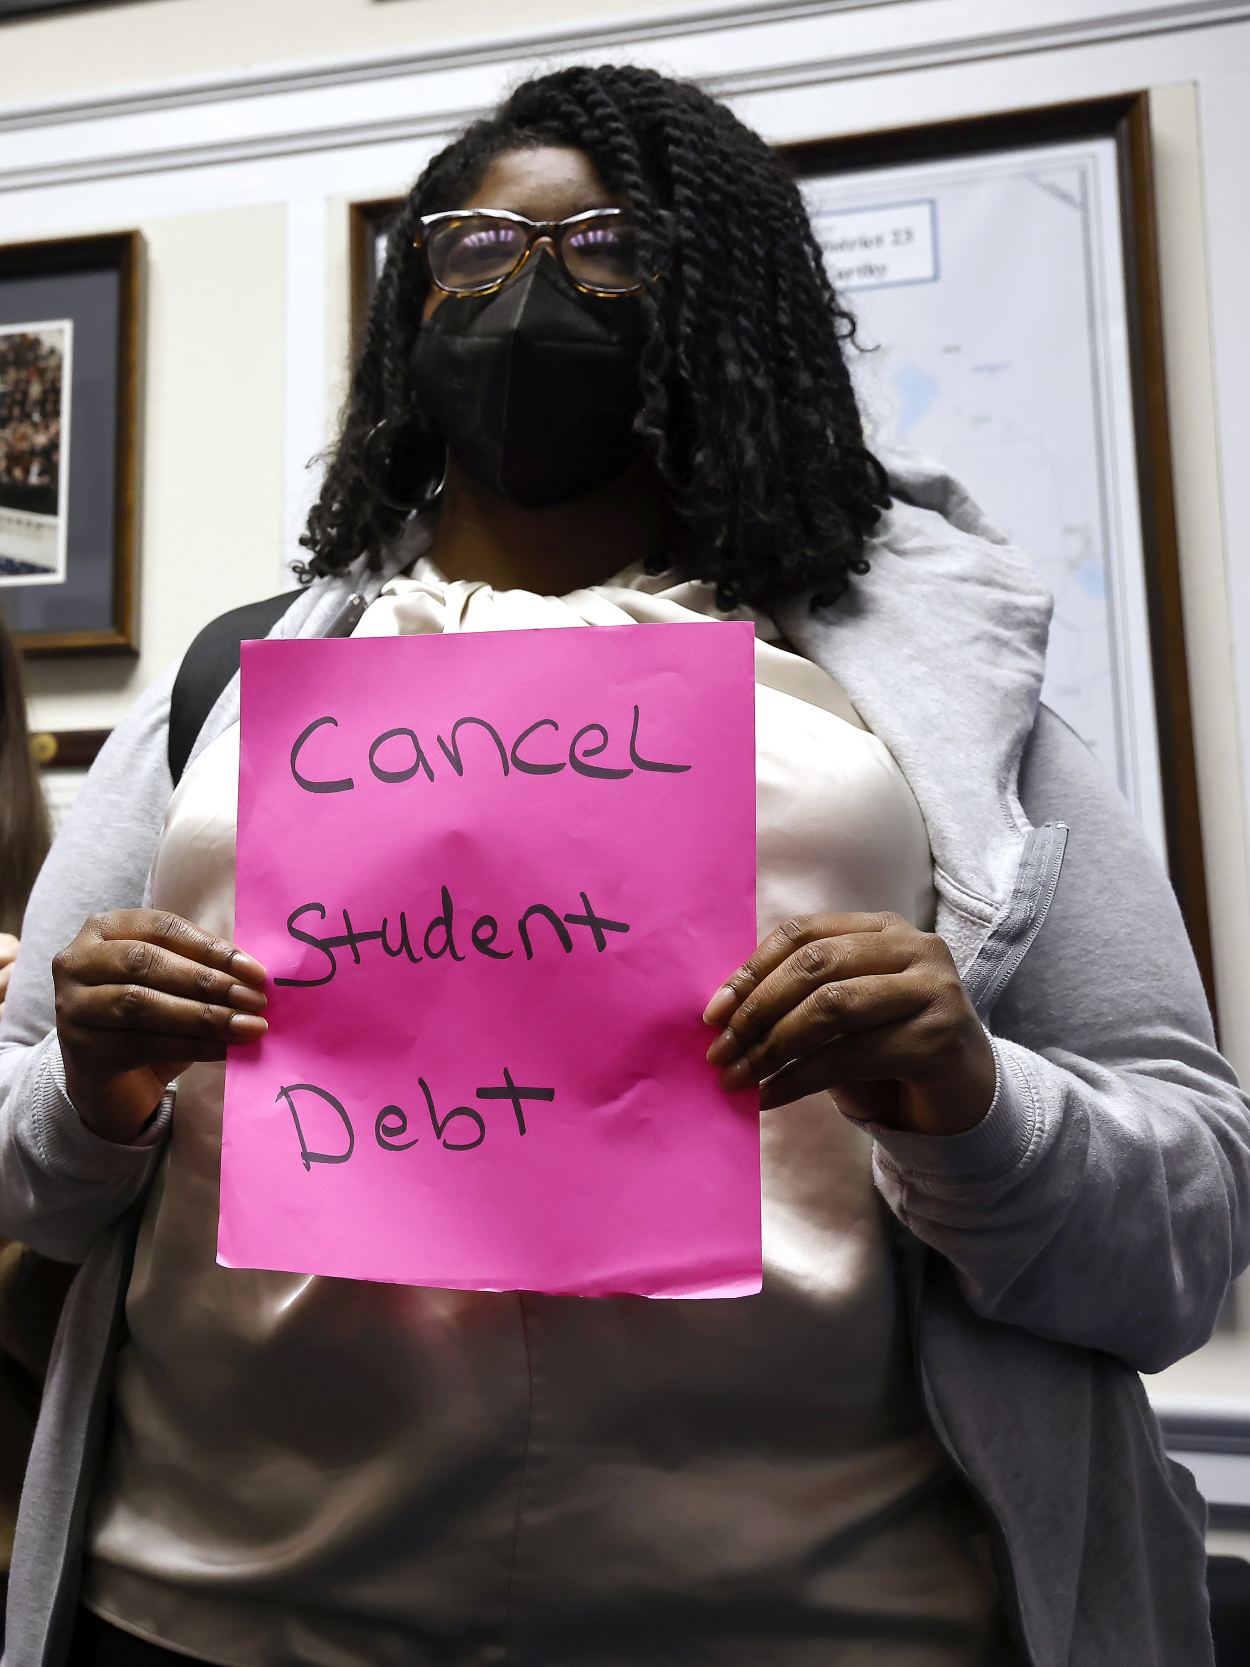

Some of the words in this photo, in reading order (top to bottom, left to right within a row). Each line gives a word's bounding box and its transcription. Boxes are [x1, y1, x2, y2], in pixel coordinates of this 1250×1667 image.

[290, 705, 692, 794] Cancel
[273, 885, 631, 987] Student
[275, 1066, 555, 1172] Debt
